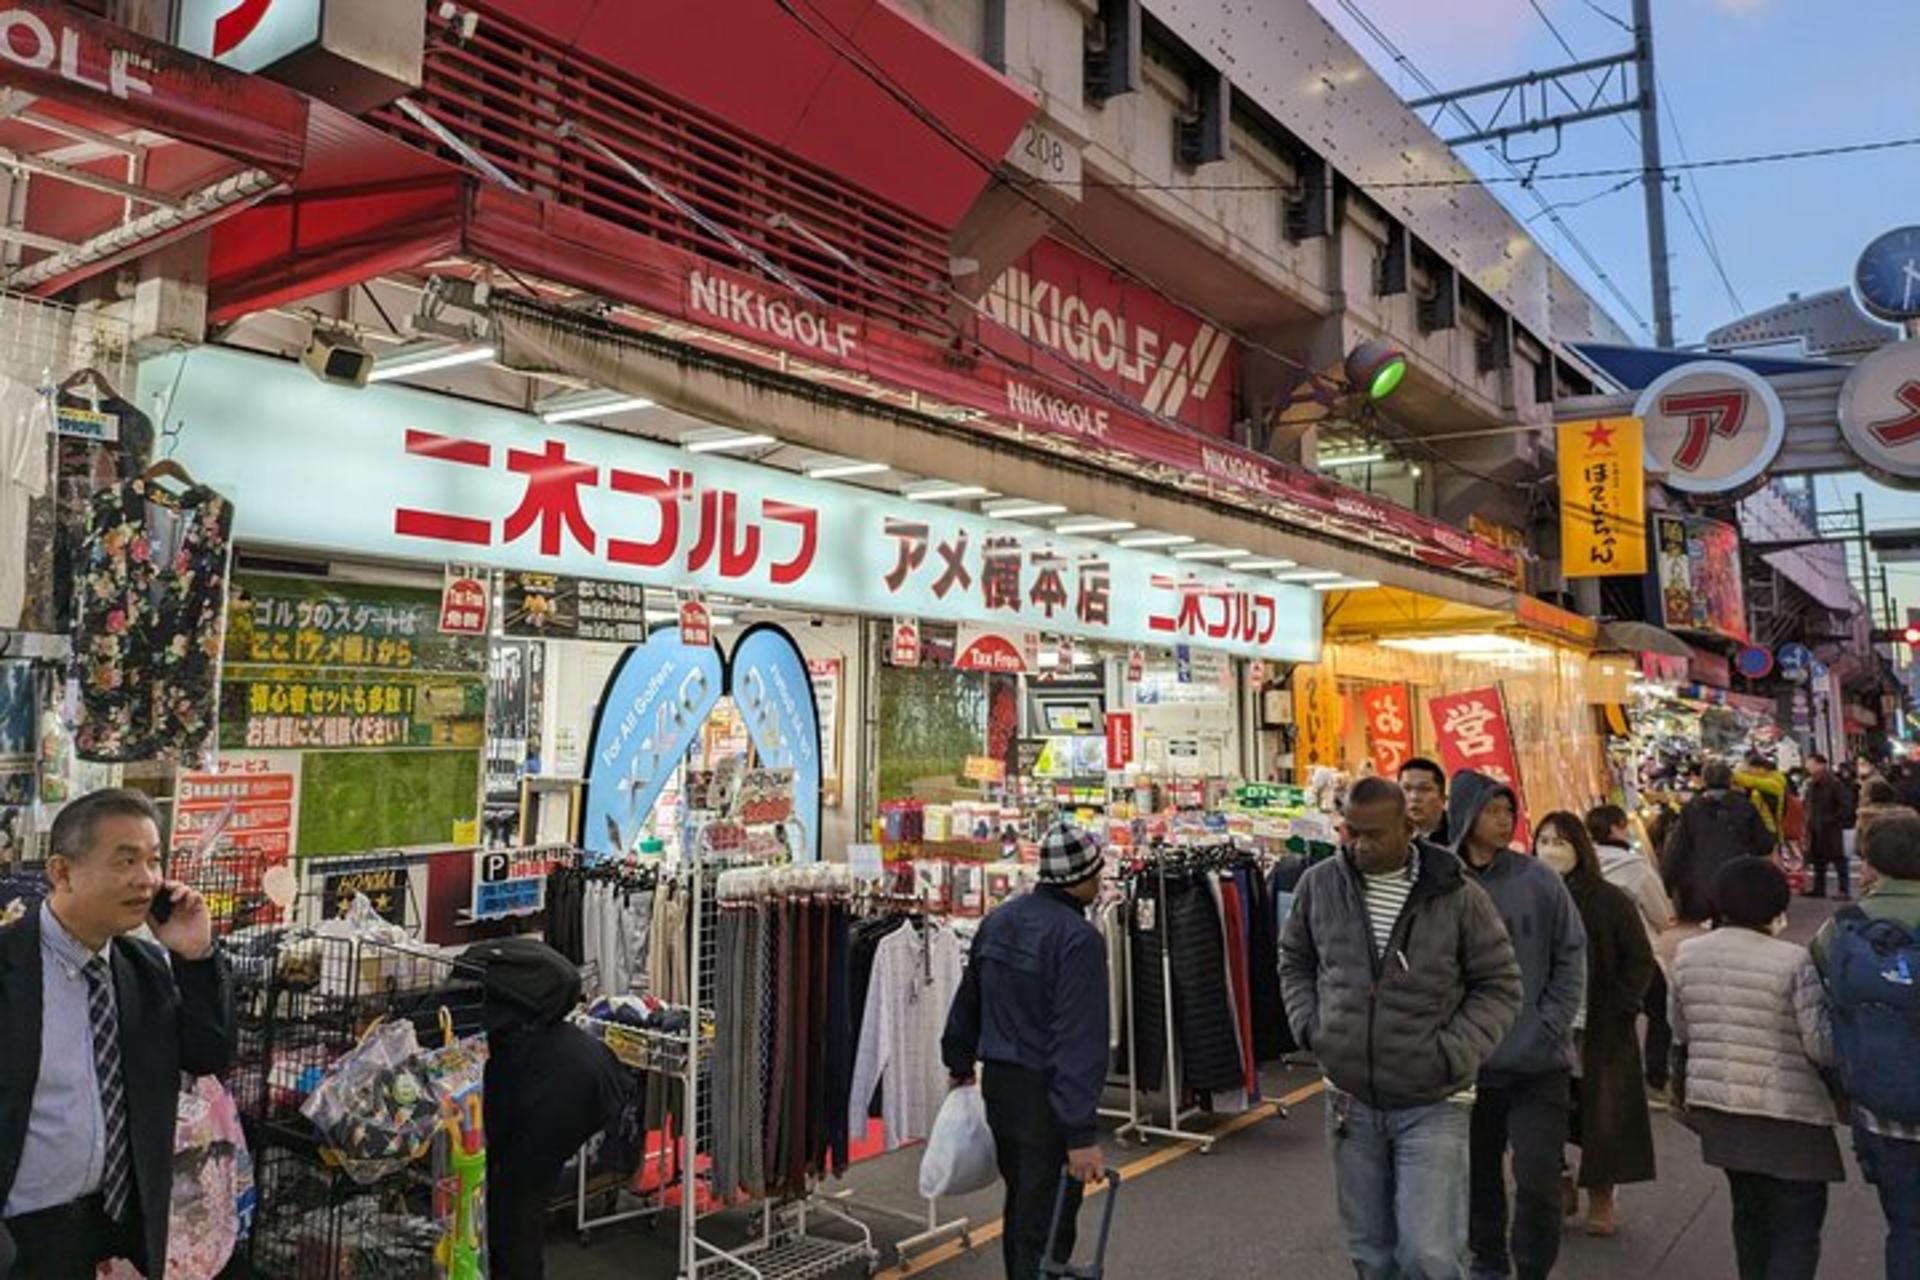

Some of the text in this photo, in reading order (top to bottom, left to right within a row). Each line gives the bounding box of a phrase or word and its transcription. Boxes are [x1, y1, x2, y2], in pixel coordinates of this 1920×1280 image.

[1024, 125, 1065, 173] 208
[689, 270, 857, 358] NIKIGOLF
[1006, 379, 1110, 437] NIKIGOLF
[1660, 389, 1749, 471] ア
[884, 516, 1111, 626] アメ横本店
[970, 647, 1020, 669] Tax Free
[489, 855, 505, 881] P
